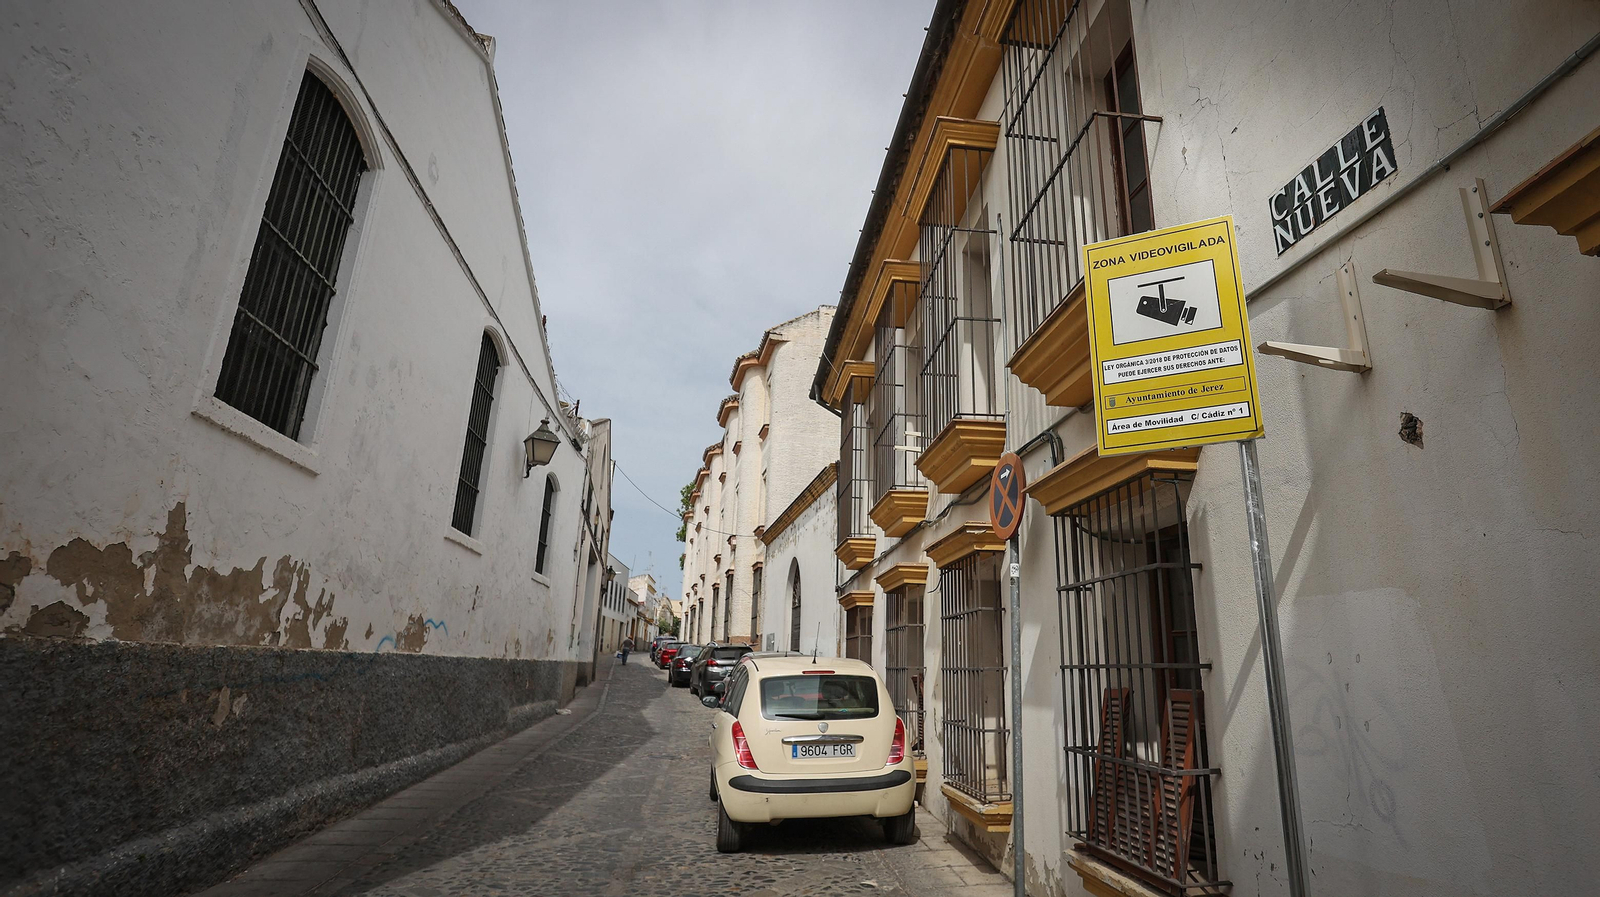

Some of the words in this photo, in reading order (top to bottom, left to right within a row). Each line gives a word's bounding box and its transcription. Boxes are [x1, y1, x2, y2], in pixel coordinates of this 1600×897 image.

[1271, 109, 1386, 221] CALLE
[1274, 146, 1396, 254] NUEVA
[1092, 256, 1126, 270] ZONA
[1129, 235, 1226, 262] VIDEOVIGILADA
[1115, 360, 1144, 370] ORGÁNICA
[1172, 349, 1209, 361] PROTECCIÓN
[1219, 345, 1239, 354] DATOS
[1118, 370, 1136, 378] PUEDE
[1137, 366, 1162, 376] EJERCER
[1175, 360, 1207, 369] DERECHOS
[1207, 357, 1225, 365] ANTE:
[1125, 389, 1186, 405] Ayuntamiento
[1188, 387, 1198, 395] de
[1201, 384, 1224, 393] Jerez
[1112, 423, 1131, 431] Área
[1145, 415, 1184, 427] Movilidad
[1191, 413, 1200, 421] C/
[1201, 410, 1225, 419] Cádiz
[800, 744, 827, 757] 9604
[833, 744, 853, 755] FGR
